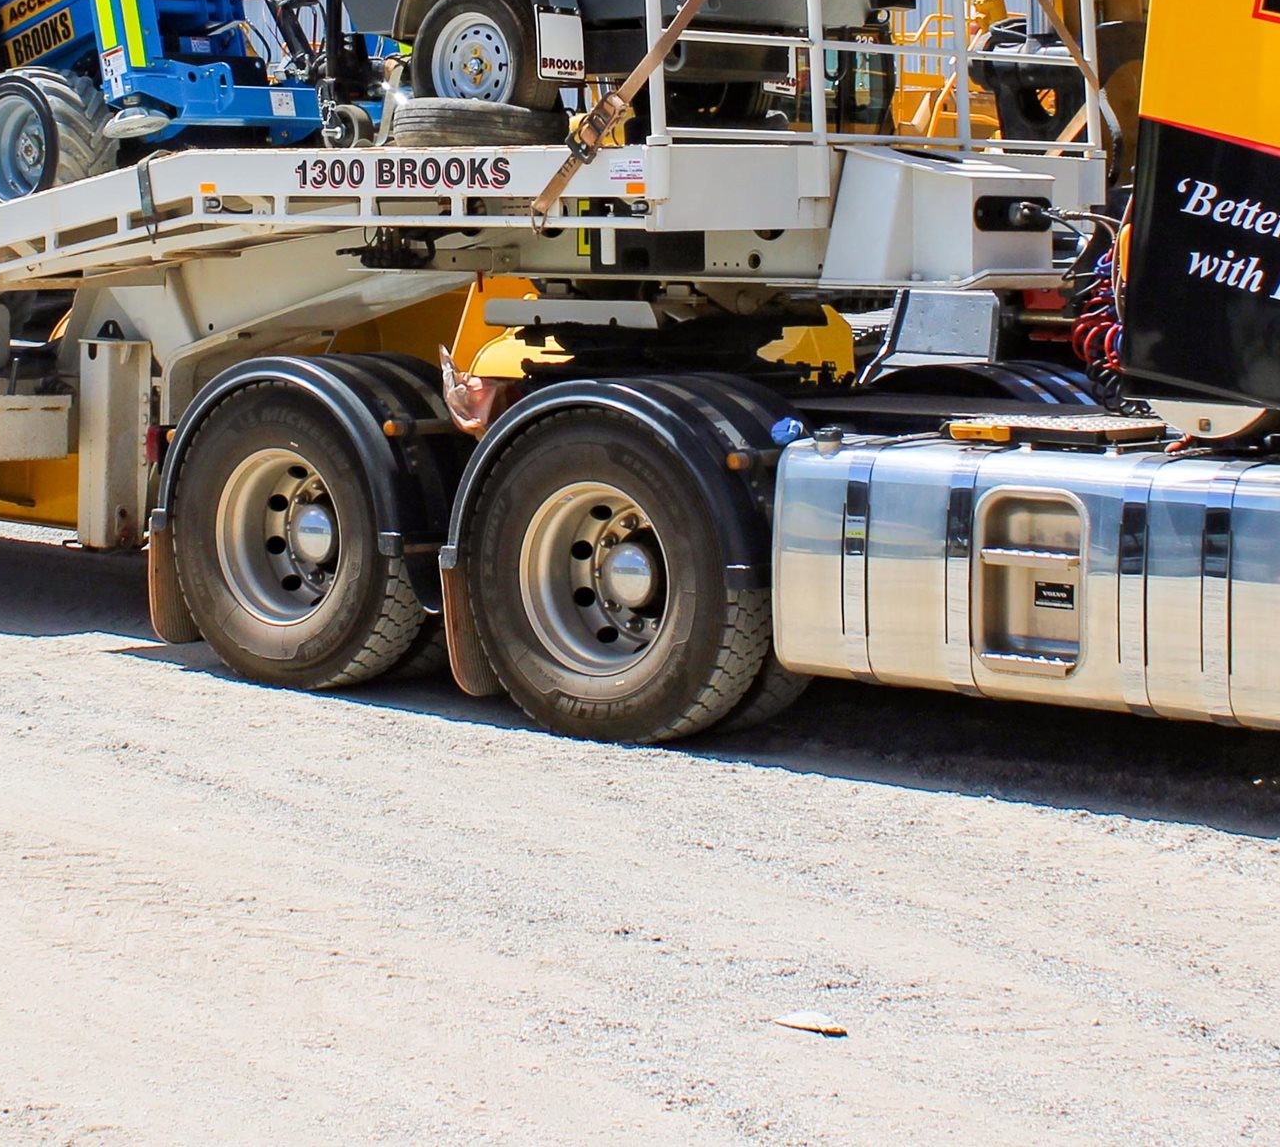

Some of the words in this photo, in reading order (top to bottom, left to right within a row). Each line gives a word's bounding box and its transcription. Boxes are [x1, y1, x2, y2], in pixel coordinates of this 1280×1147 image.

[12, 16, 71, 65] BROOKS
[542, 57, 584, 71] BROOKS
[295, 158, 365, 189] 1300
[375, 157, 511, 189] BROOKS
[1187, 249, 1264, 293] with
[1042, 590, 1068, 599] VOLVO
